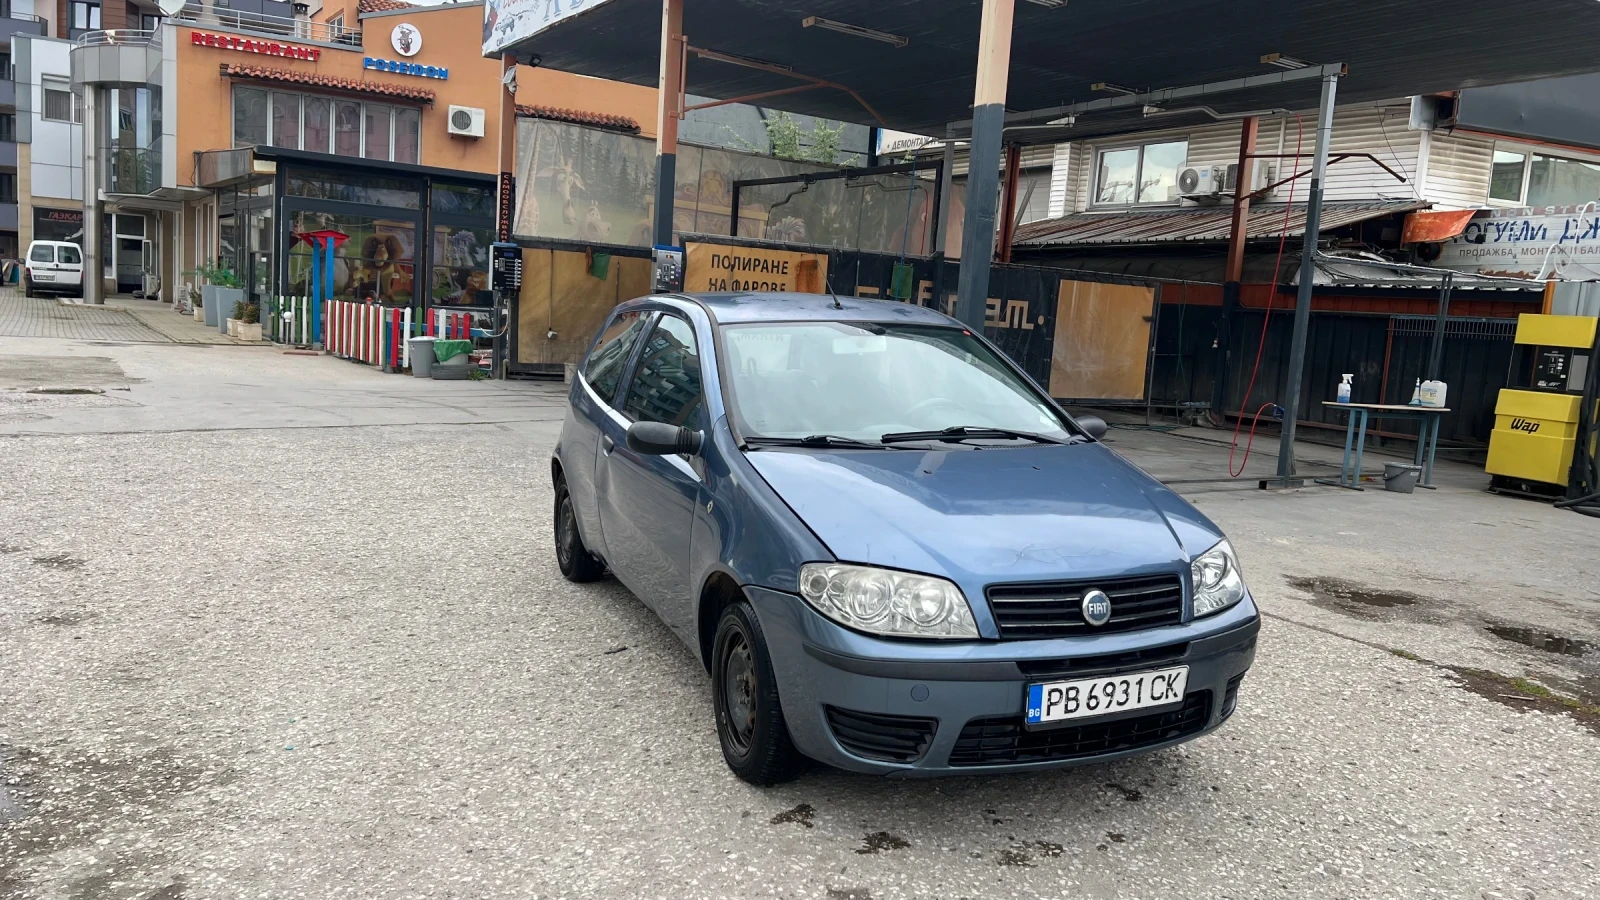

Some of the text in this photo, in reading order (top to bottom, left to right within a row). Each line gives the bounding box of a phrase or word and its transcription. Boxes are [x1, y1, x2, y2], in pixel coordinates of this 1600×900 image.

[190, 31, 321, 61] RESTAURANT
[363, 57, 449, 80] POSEIDON
[1490, 207, 1534, 218] NON
[1521, 246, 1567, 256] МОНТАЖ
[711, 253, 789, 275] ПОЛИРАНЕ
[731, 279, 786, 292] ФАРОВЕ
[1510, 417, 1541, 435] Wap
[1088, 602, 1107, 615] FIAT
[1046, 671, 1182, 717] PB 6931 CK
[1028, 708, 1040, 718] BG
